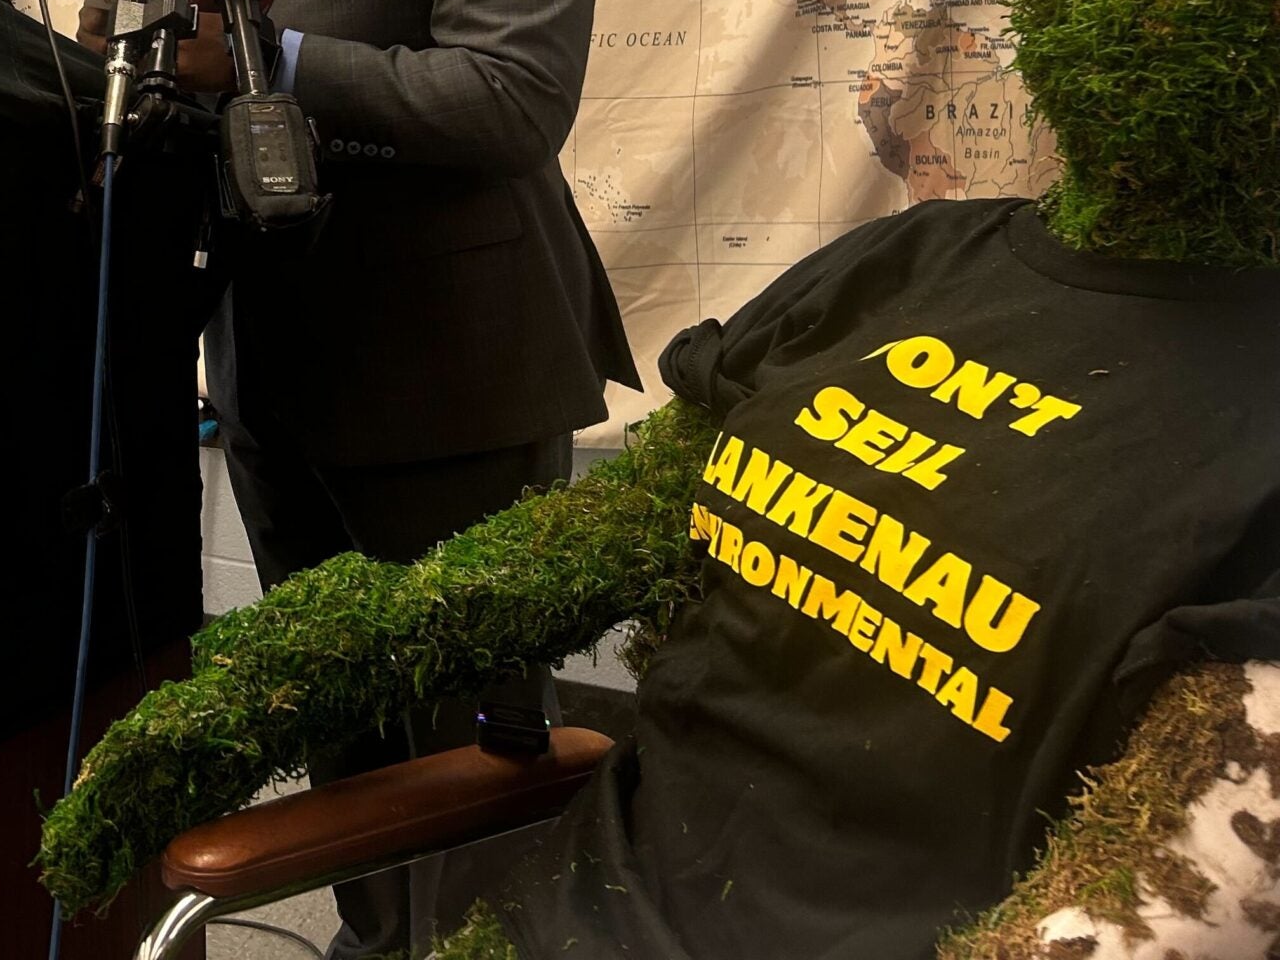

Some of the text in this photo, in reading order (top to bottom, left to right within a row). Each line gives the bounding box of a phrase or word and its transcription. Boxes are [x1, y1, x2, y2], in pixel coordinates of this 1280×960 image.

[812, 22, 848, 33] COSTA RICA
[626, 31, 688, 47] OCEAN
[846, 30, 871, 38] PANAMA
[872, 62, 903, 72] COLOMBIA
[848, 84, 873, 92] ECUADOR
[956, 126, 1006, 138] Amazon
[964, 148, 1000, 160] Basin
[915, 155, 948, 165] BOLIVIA
[859, 335, 1082, 437] ON'T
[793, 386, 967, 491] SELL
